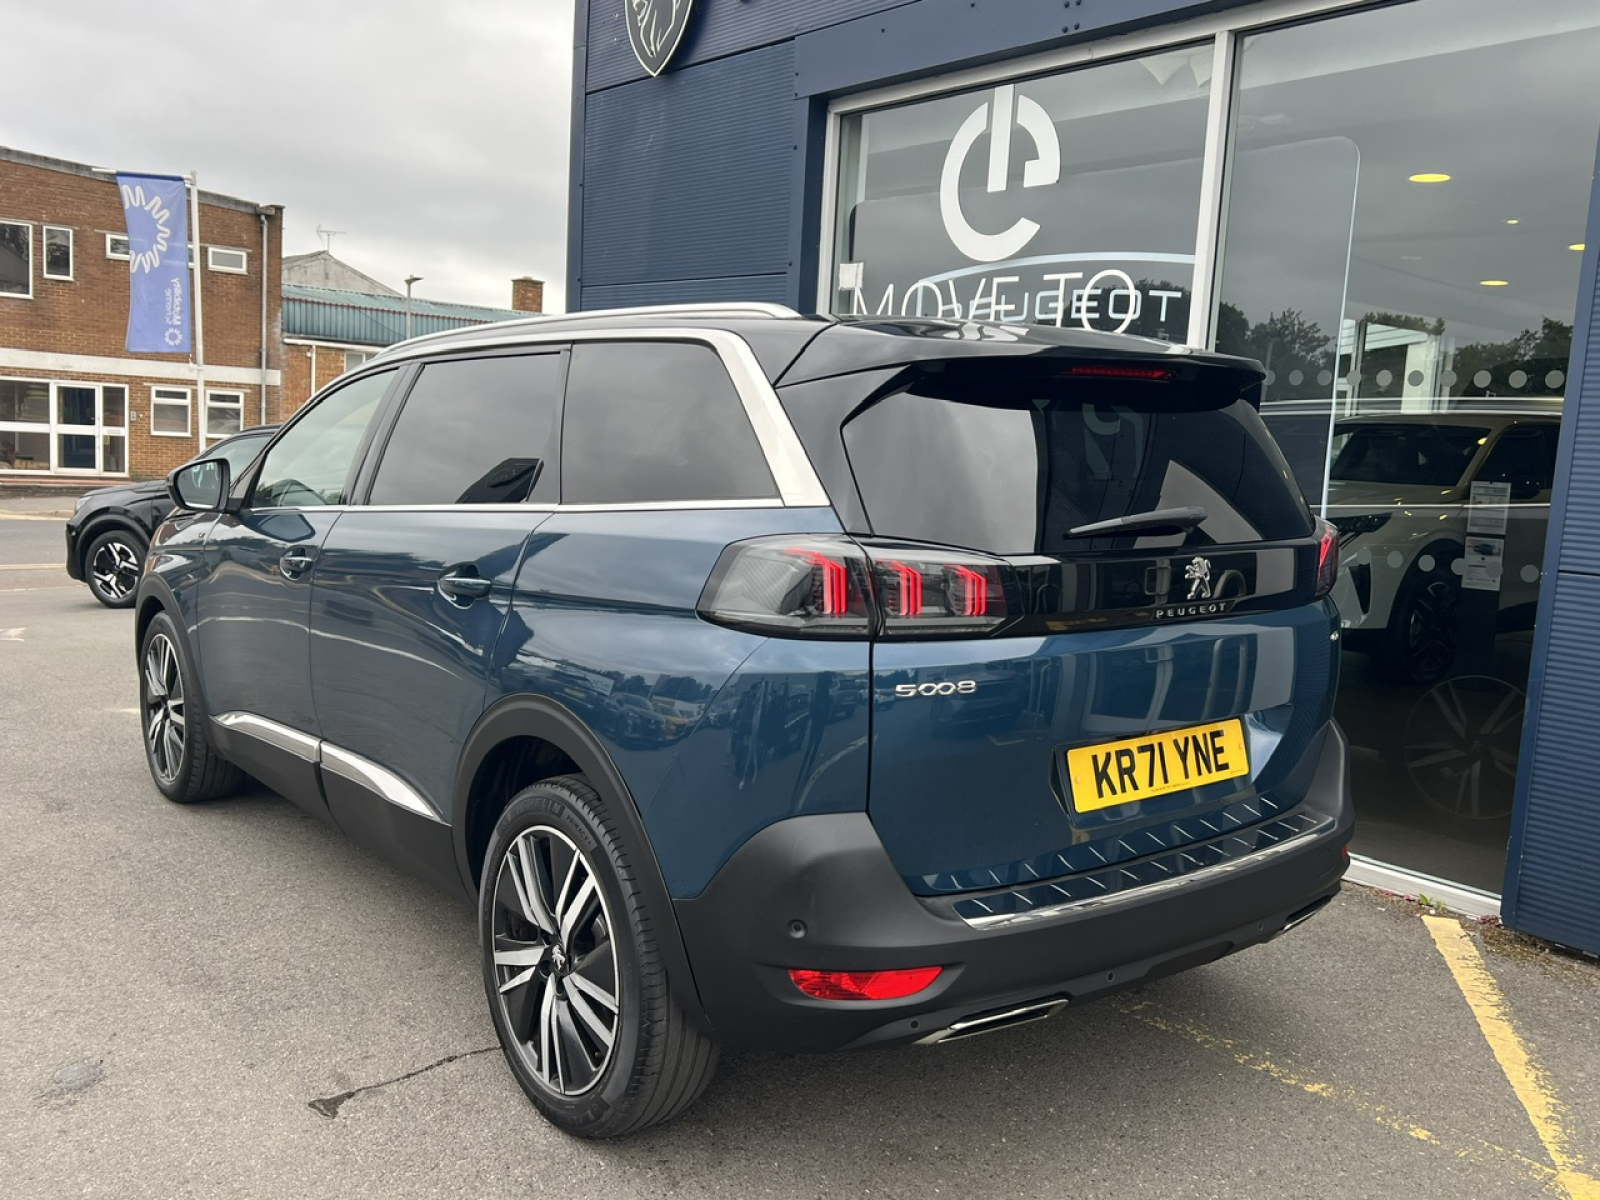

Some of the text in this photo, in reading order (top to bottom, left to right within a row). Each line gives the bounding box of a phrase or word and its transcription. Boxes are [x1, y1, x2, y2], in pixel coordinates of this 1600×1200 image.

[853, 269, 1136, 334] MOVE TO
[1155, 602, 1228, 620] PEUGEOT
[894, 679, 978, 699] 5008
[1091, 729, 1230, 799] KR71 YNE
